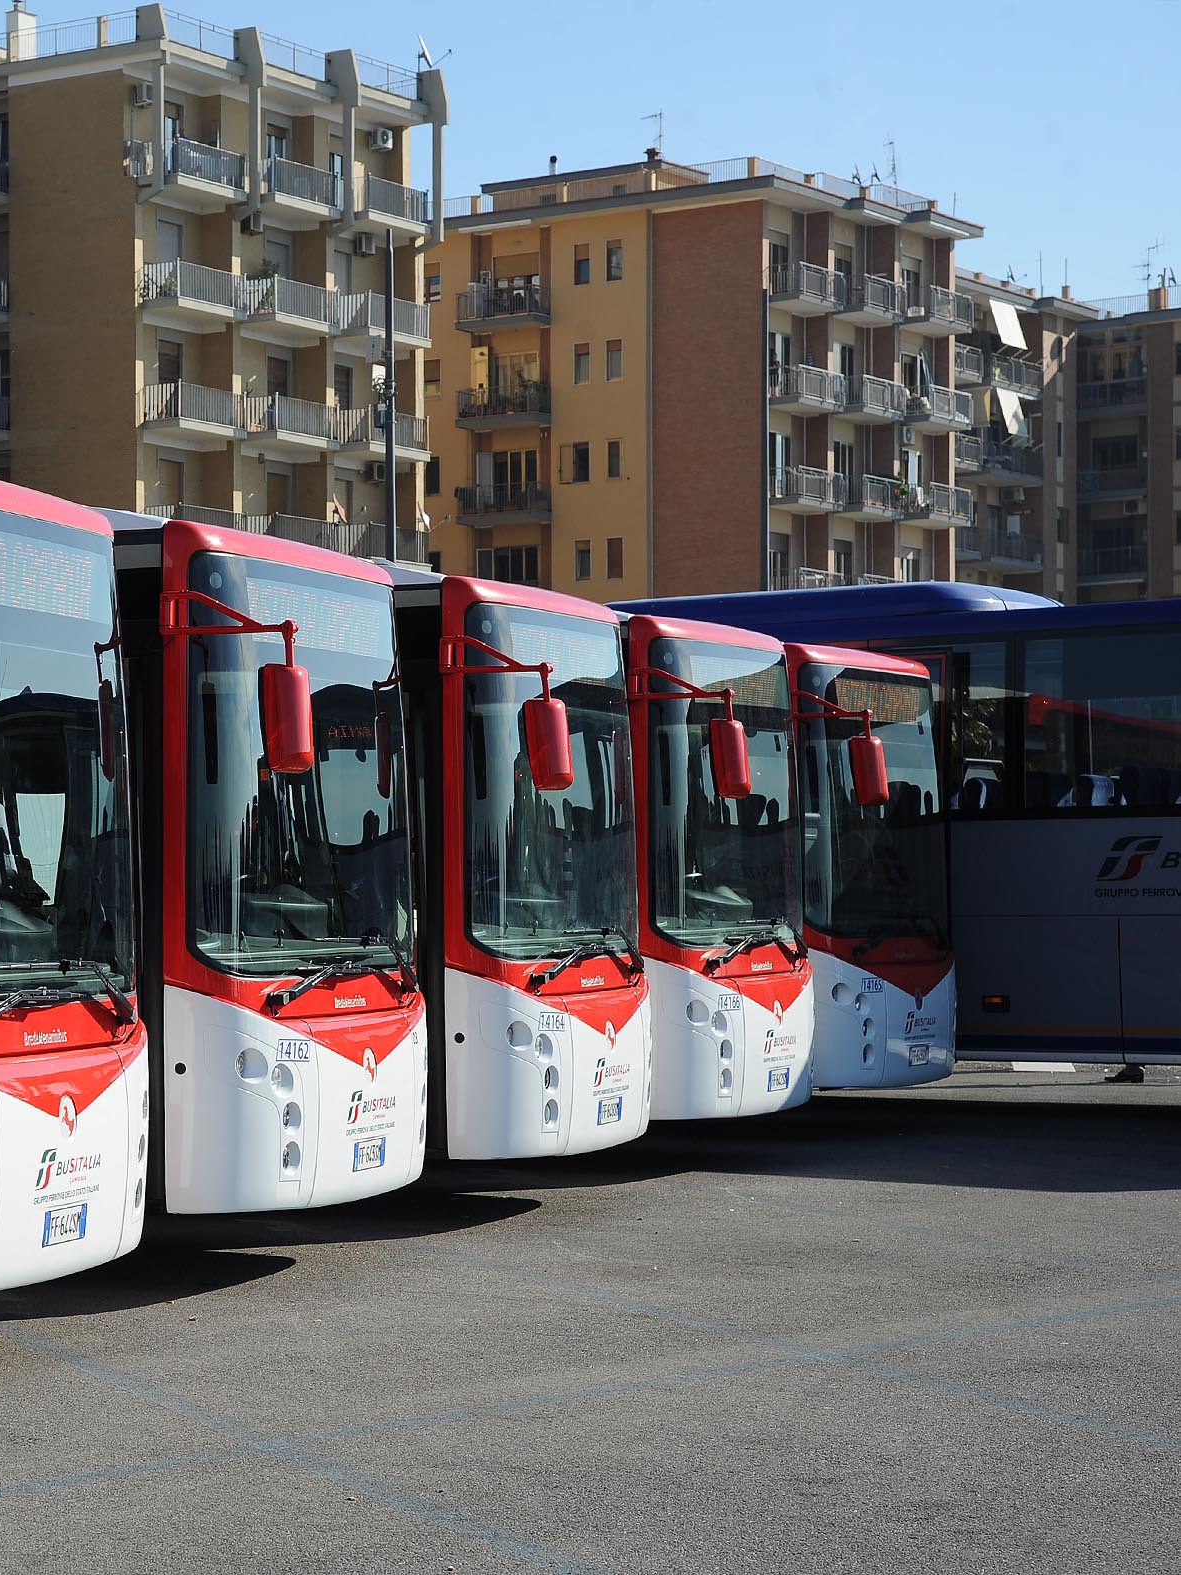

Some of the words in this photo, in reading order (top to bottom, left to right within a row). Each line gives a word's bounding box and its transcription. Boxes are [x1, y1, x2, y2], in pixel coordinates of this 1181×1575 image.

[1095, 888, 1139, 898] GRUPPO
[862, 979, 883, 991] 14165
[720, 995, 741, 1010] 14166
[540, 1014, 565, 1030] 14164
[279, 1041, 309, 1060] 14162
[362, 1096, 396, 1113] BUSITALIA
[56, 1153, 101, 1177] BUSITALIA
